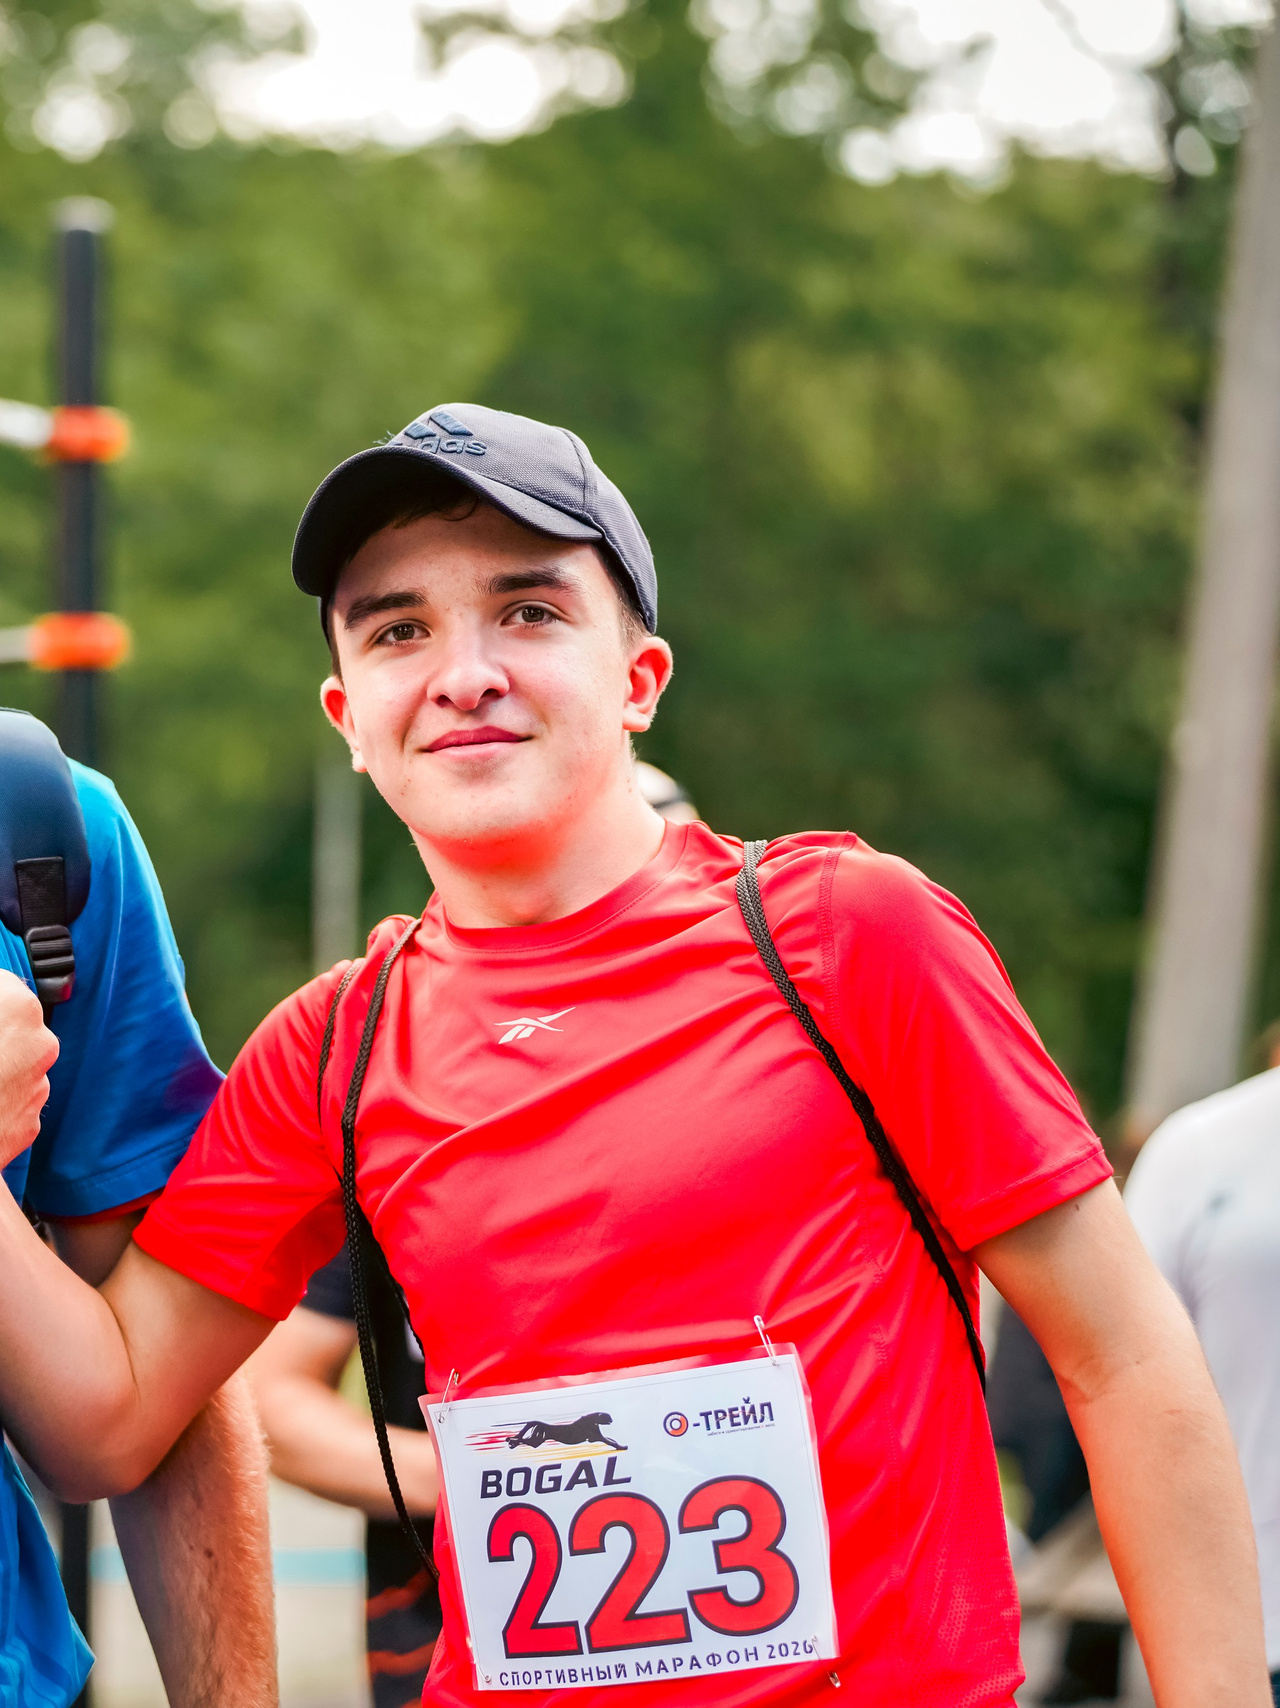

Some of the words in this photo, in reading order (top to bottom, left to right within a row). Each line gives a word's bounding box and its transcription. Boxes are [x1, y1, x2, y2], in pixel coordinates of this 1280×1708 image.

[480, 1456, 632, 1498] BOGAL
[486, 1474, 800, 1659] 223
[499, 1662, 628, 1686] СПОРТИВНЫЙ
[635, 1646, 759, 1677] МАРАФОН
[766, 1639, 813, 1660] 2026
